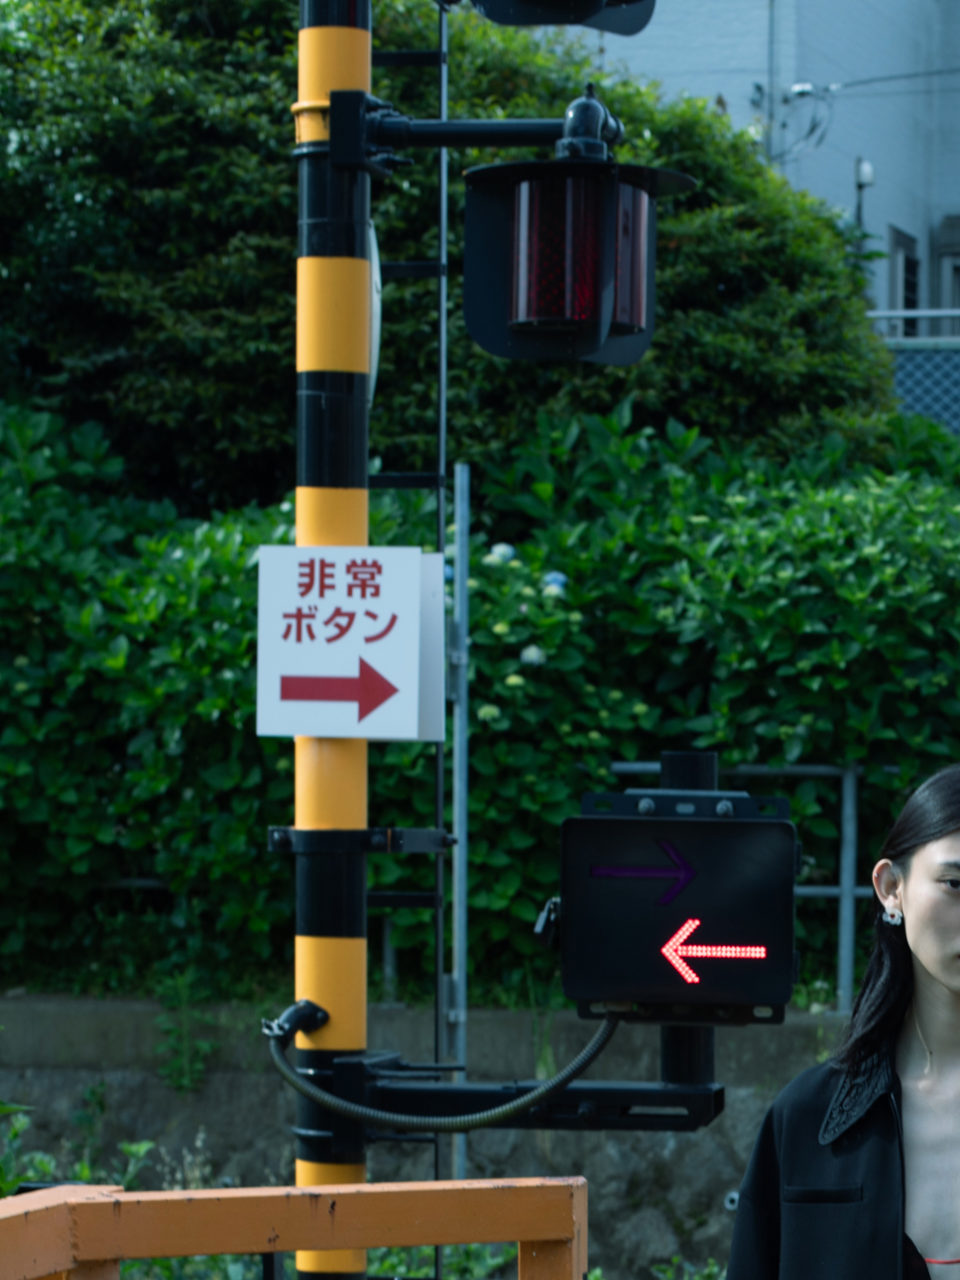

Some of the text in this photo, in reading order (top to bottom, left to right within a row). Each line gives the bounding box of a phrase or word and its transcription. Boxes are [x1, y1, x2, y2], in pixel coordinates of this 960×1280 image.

[298, 558, 382, 599] 非常
[282, 605, 398, 643] ボタン
